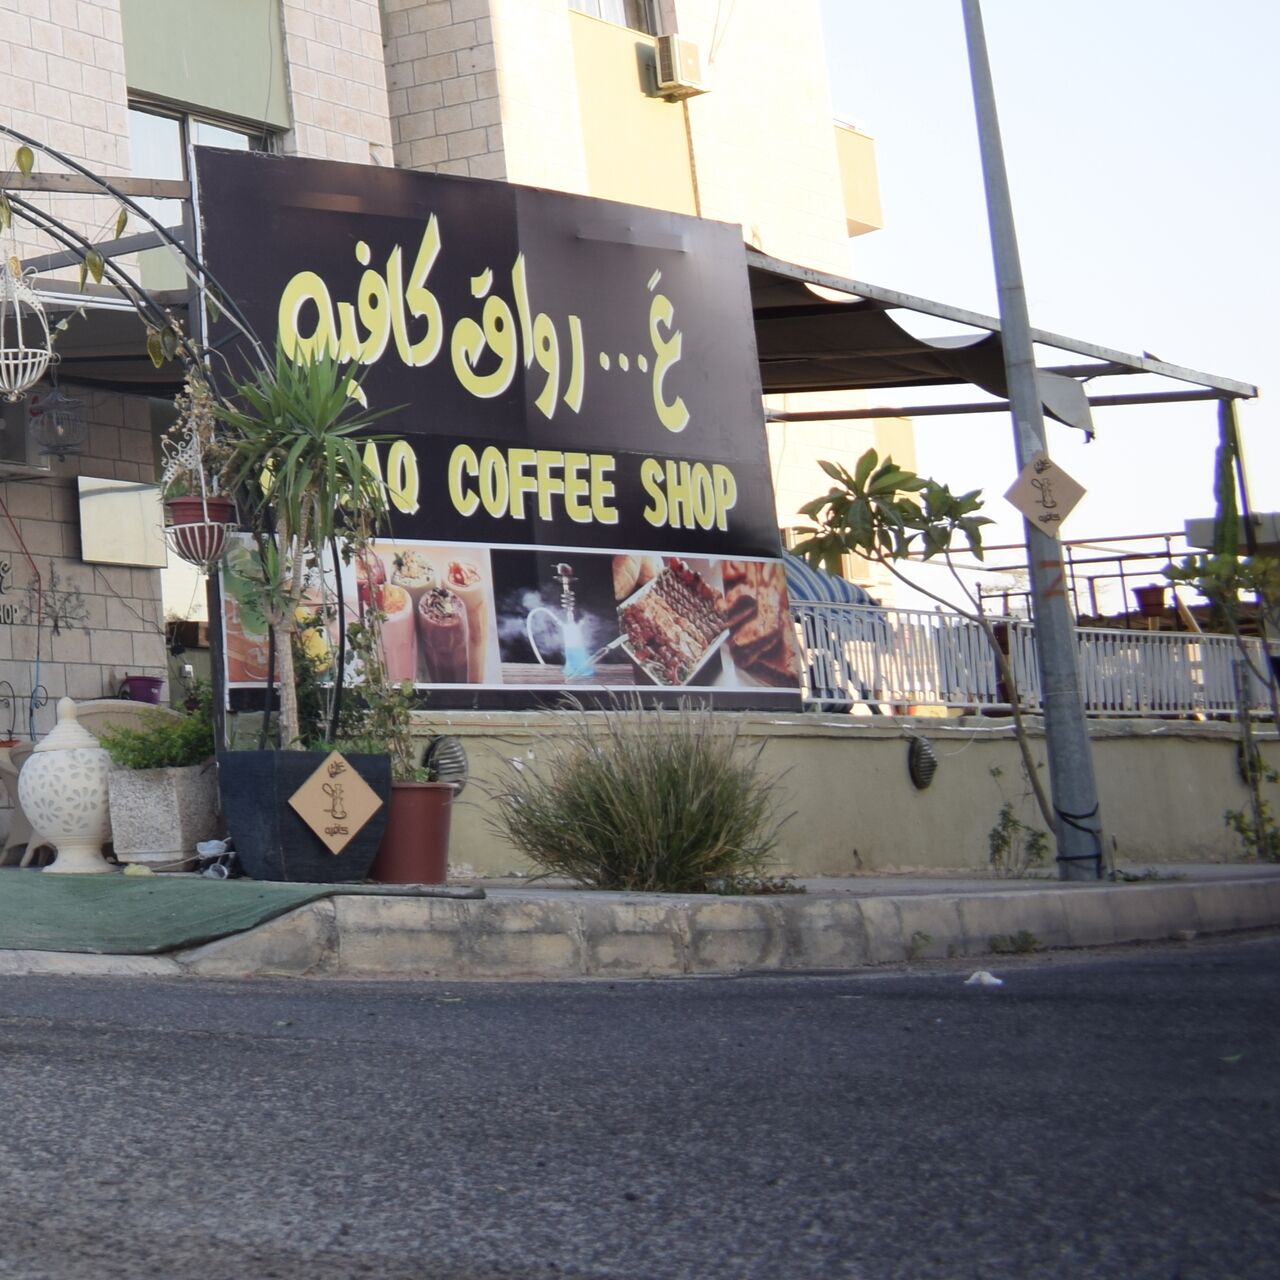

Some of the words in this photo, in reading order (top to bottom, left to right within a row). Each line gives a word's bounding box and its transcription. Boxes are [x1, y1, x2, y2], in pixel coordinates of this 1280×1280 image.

[451, 252, 586, 419] رواق
[448, 443, 620, 524] COFFEE
[640, 458, 738, 533] SHOP
